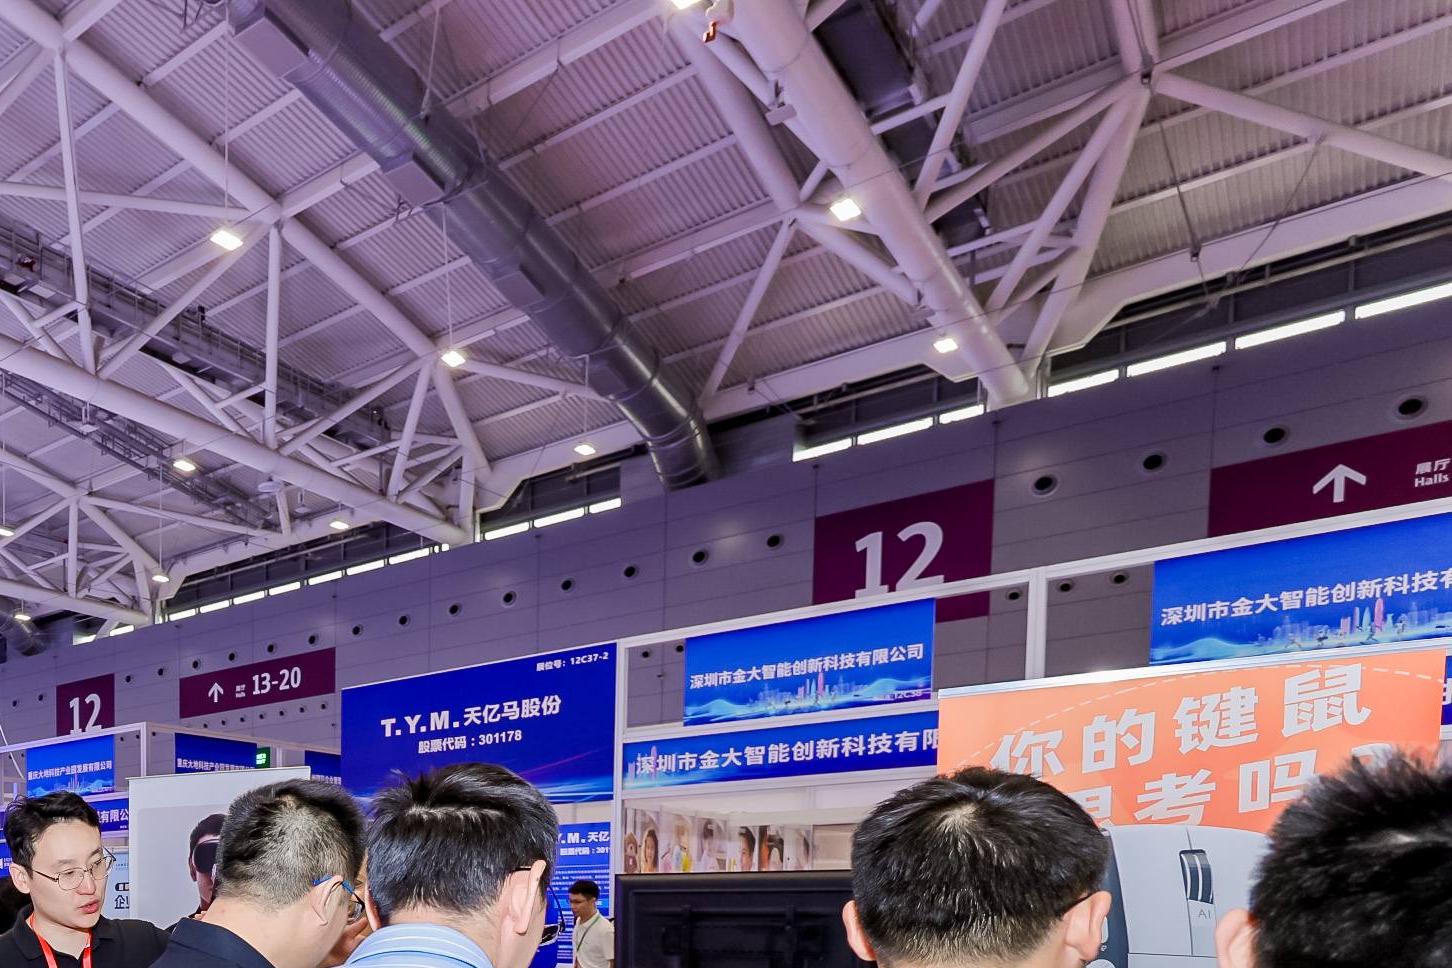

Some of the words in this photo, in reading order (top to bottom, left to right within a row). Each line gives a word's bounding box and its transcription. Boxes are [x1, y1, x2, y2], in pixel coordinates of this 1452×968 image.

[1414, 473, 1449, 487] Halls
[854, 521, 945, 599] 12
[252, 666, 302, 695] 13-20
[689, 643, 924, 690] 深圳市金大智能创新科技有限公司
[69, 693, 103, 734] 12
[990, 662, 1372, 777] 你的键鼠
[1197, 908, 1212, 919] AI
